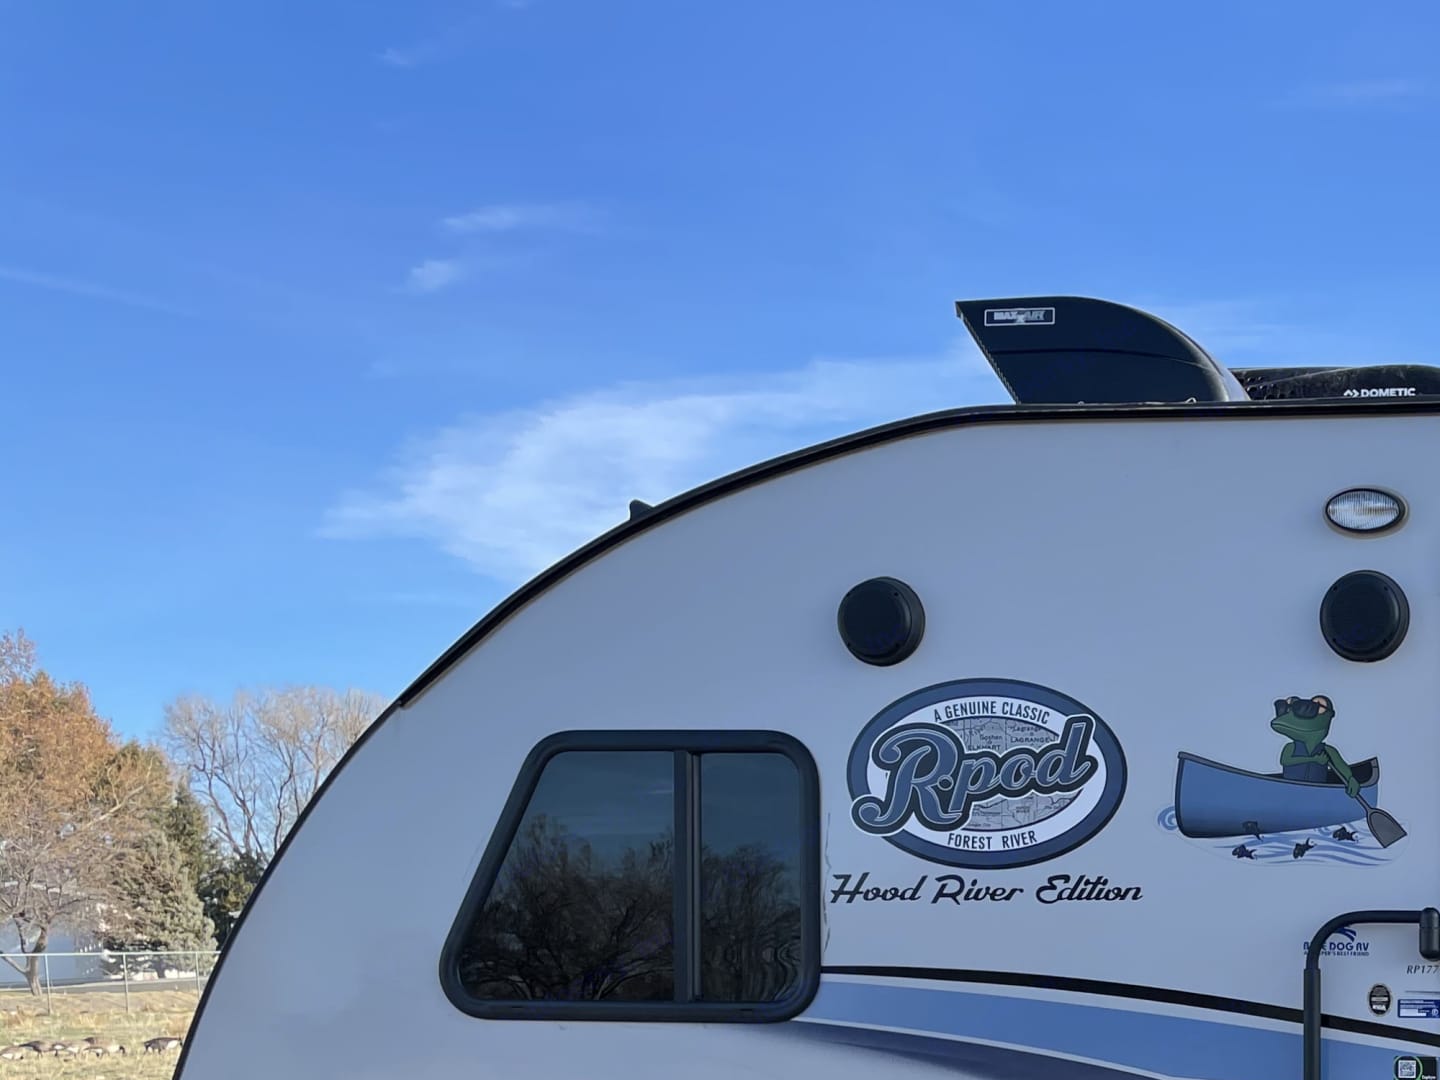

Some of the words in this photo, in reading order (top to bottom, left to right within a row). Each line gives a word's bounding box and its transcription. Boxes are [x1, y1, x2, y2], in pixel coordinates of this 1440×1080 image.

[1361, 388, 1416, 397] DOMETIC
[933, 709, 942, 723] A
[945, 701, 997, 719] GENUINE
[1001, 702, 1050, 725] CLASSIC
[947, 832, 993, 850] FOREST
[1002, 831, 1037, 850] RIVER
[830, 872, 928, 904] Hood
[931, 874, 1024, 906] River
[1036, 874, 1143, 905] Edition
[1329, 942, 1353, 951] DOG
[1406, 964, 1440, 975] RP177
